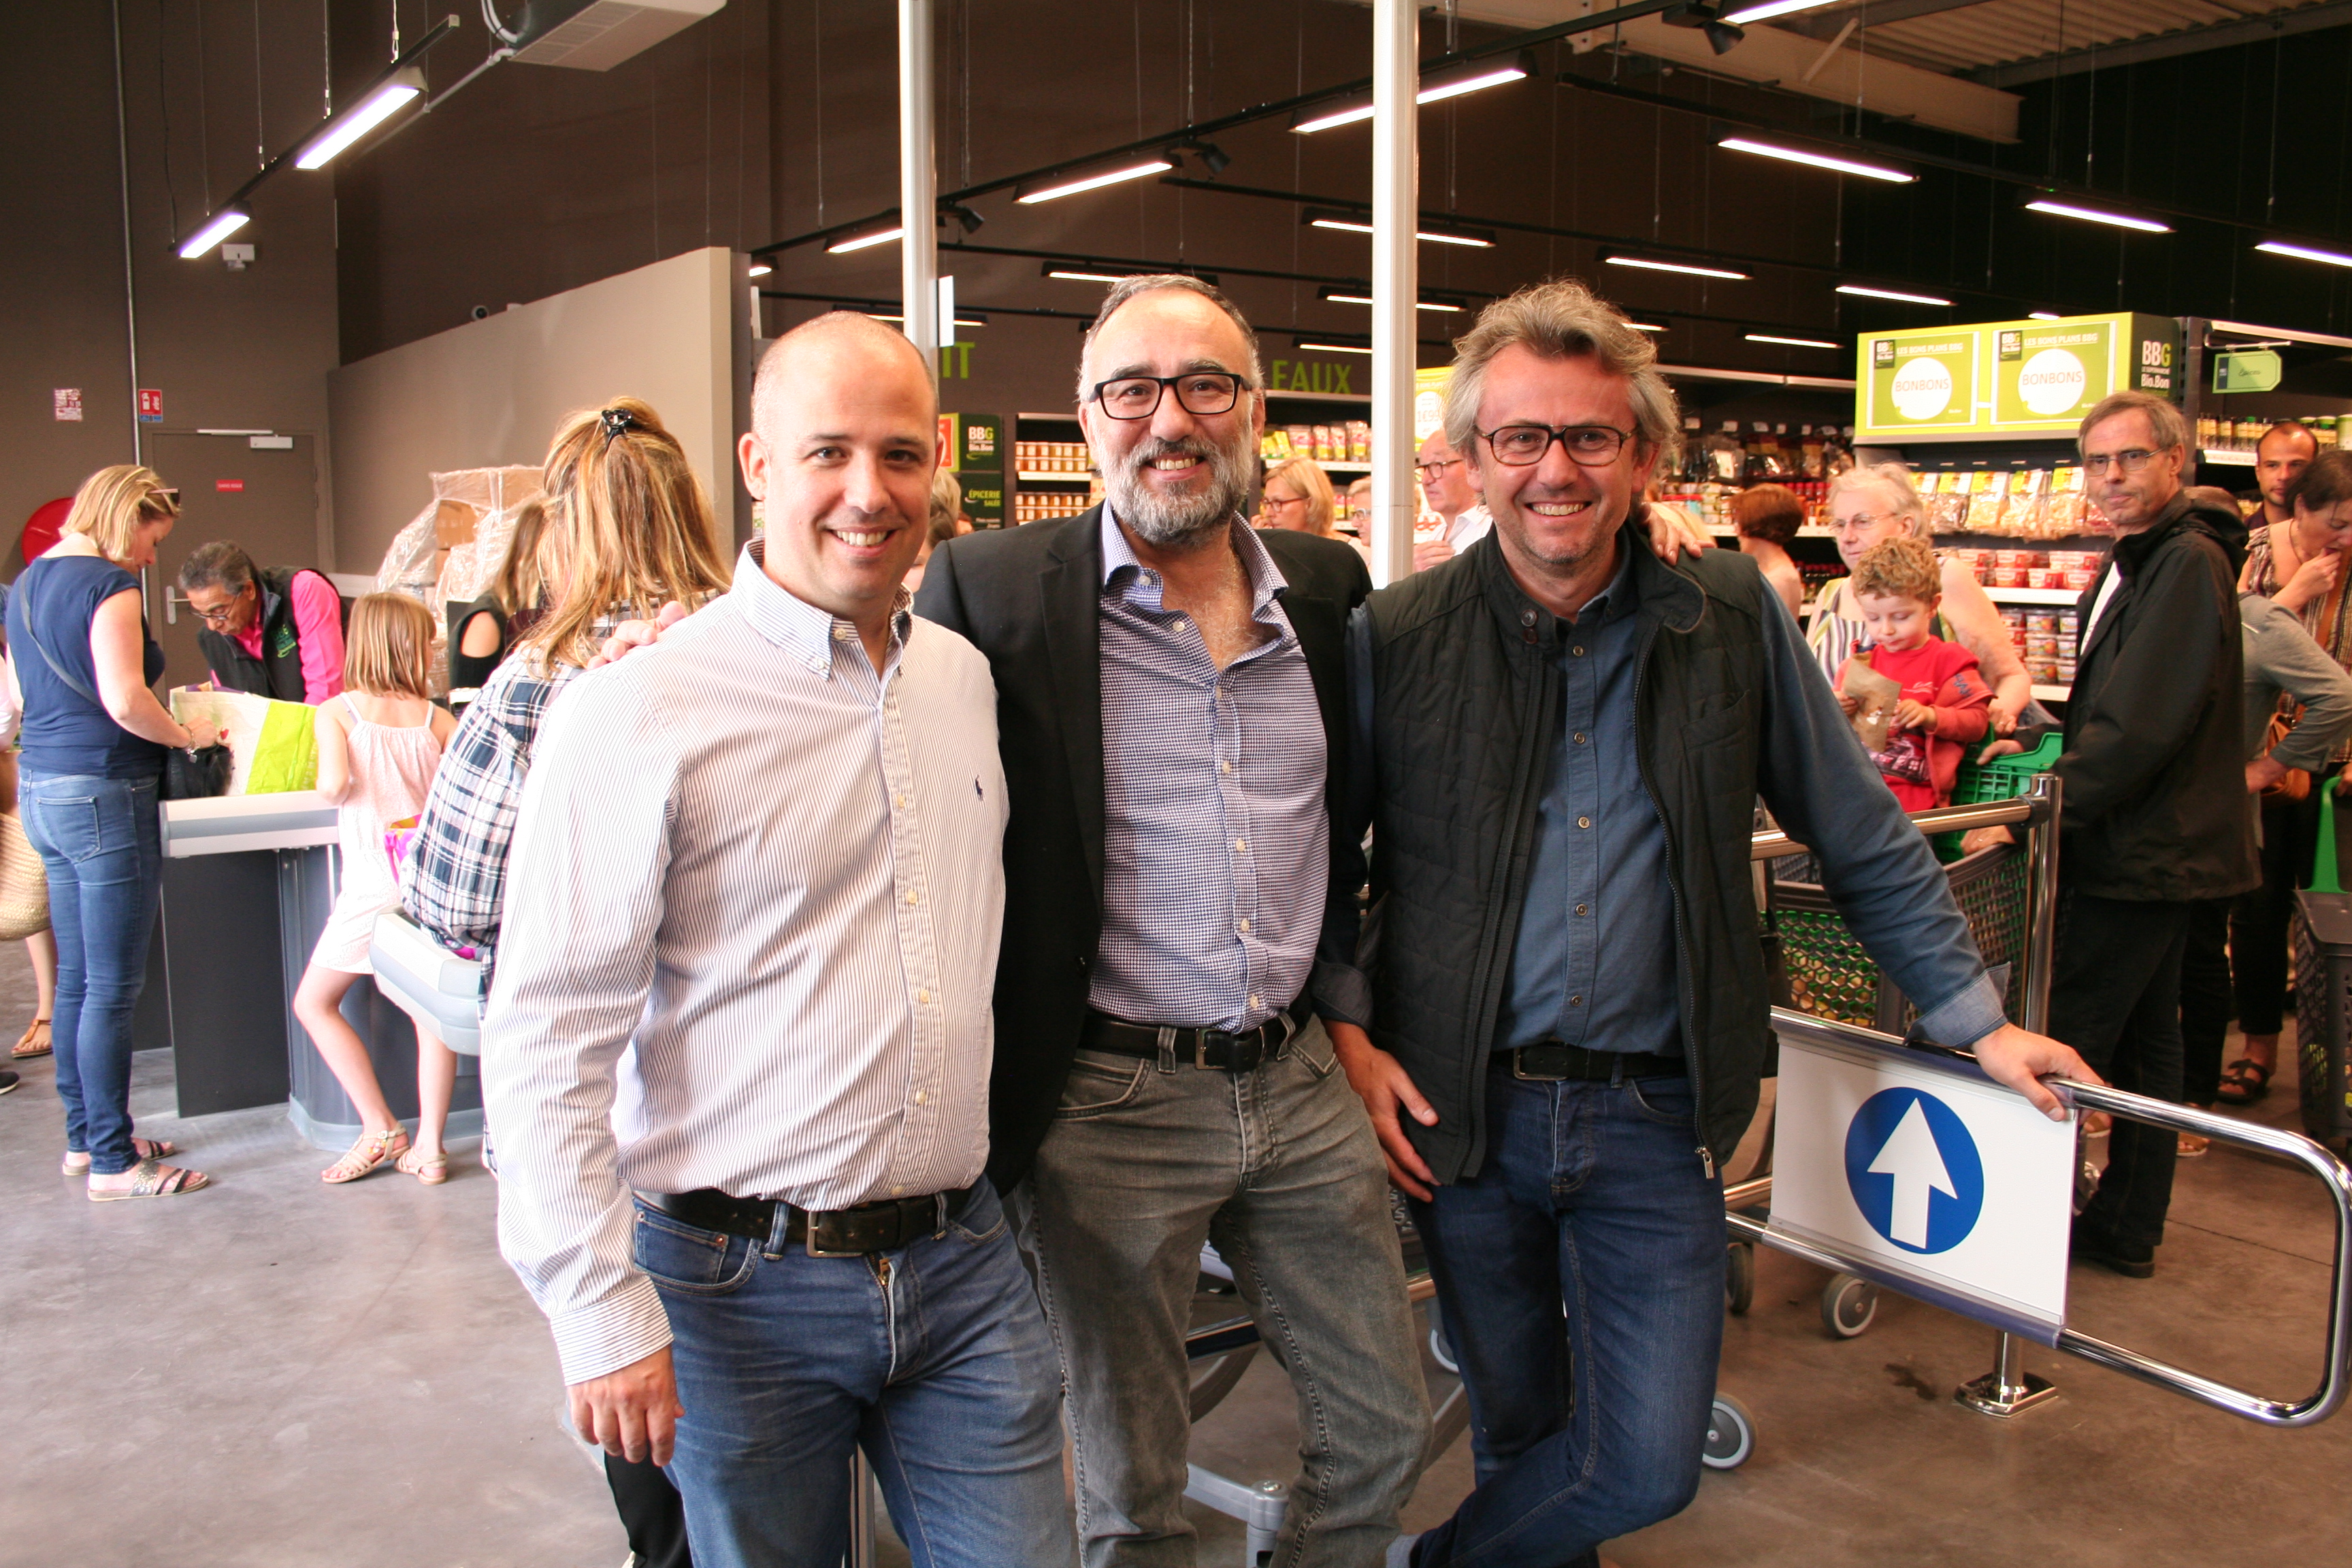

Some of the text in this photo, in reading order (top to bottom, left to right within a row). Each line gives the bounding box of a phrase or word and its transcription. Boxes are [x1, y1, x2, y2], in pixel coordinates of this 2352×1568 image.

[2024, 338, 2036, 346] LES
[2142, 340, 2171, 367] BBG
[1895, 378, 1949, 392] BONBONS
[2022, 371, 2082, 386] BONBONS
[968, 426, 994, 440] BBG
